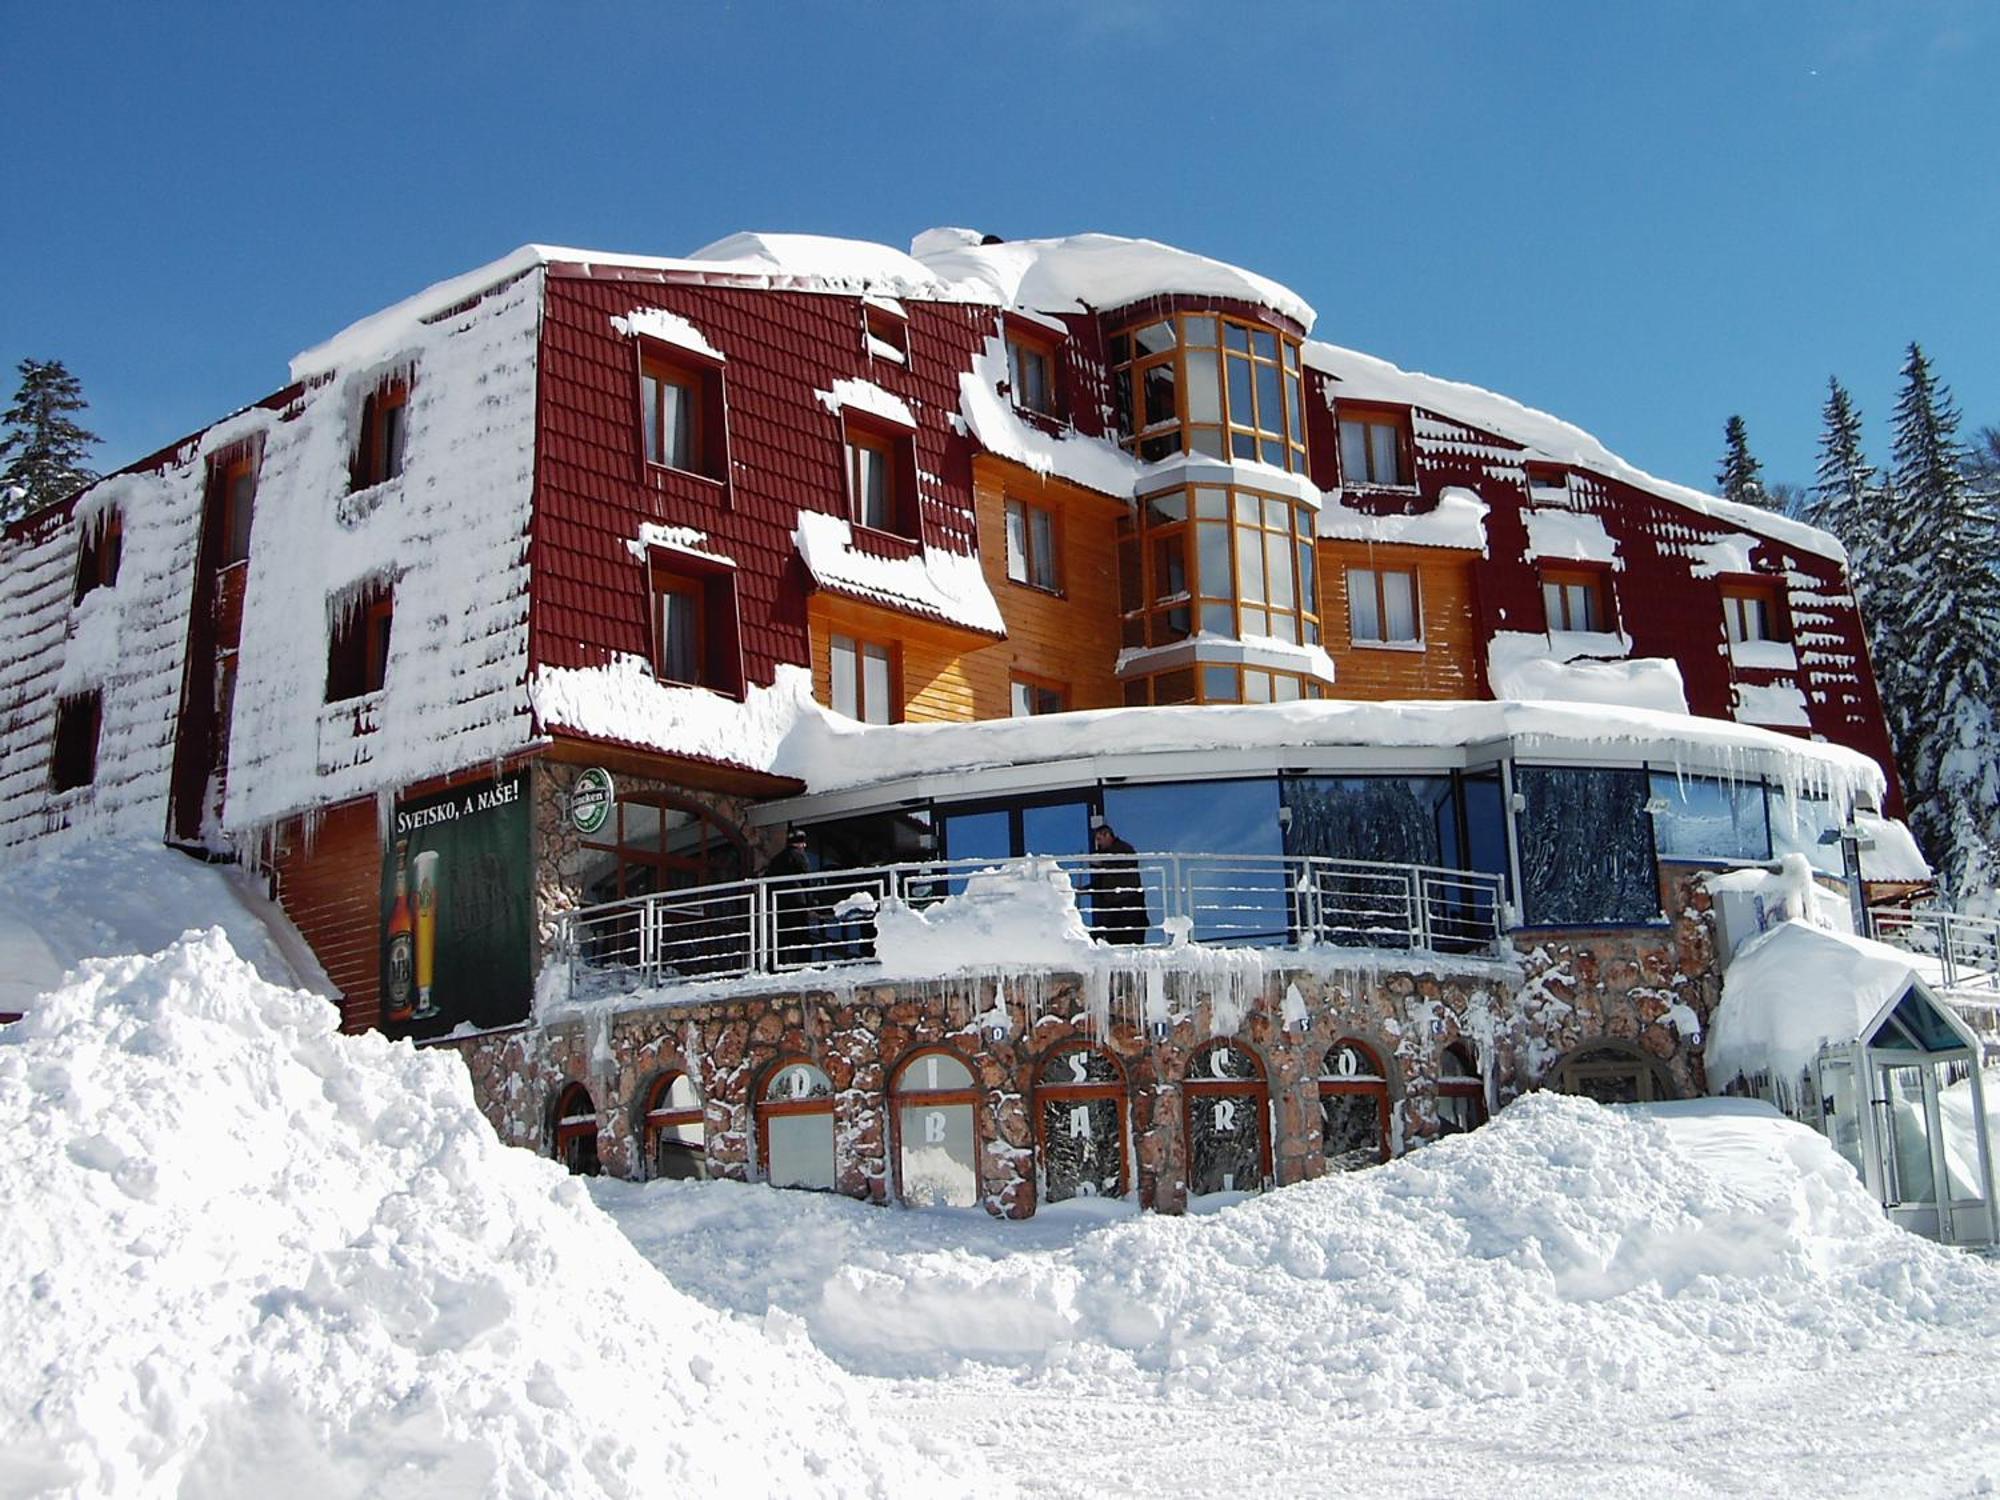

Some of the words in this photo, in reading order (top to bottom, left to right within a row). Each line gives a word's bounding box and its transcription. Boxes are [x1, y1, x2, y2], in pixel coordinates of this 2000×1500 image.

[463, 796, 475, 815] A
[477, 779, 519, 811] NAŠE!
[1068, 1051, 1088, 1083] S
[1209, 1047, 1229, 1079] C
[924, 1112, 946, 1143] B
[1070, 1106, 1090, 1139] A
[1214, 1099, 1235, 1131] R
